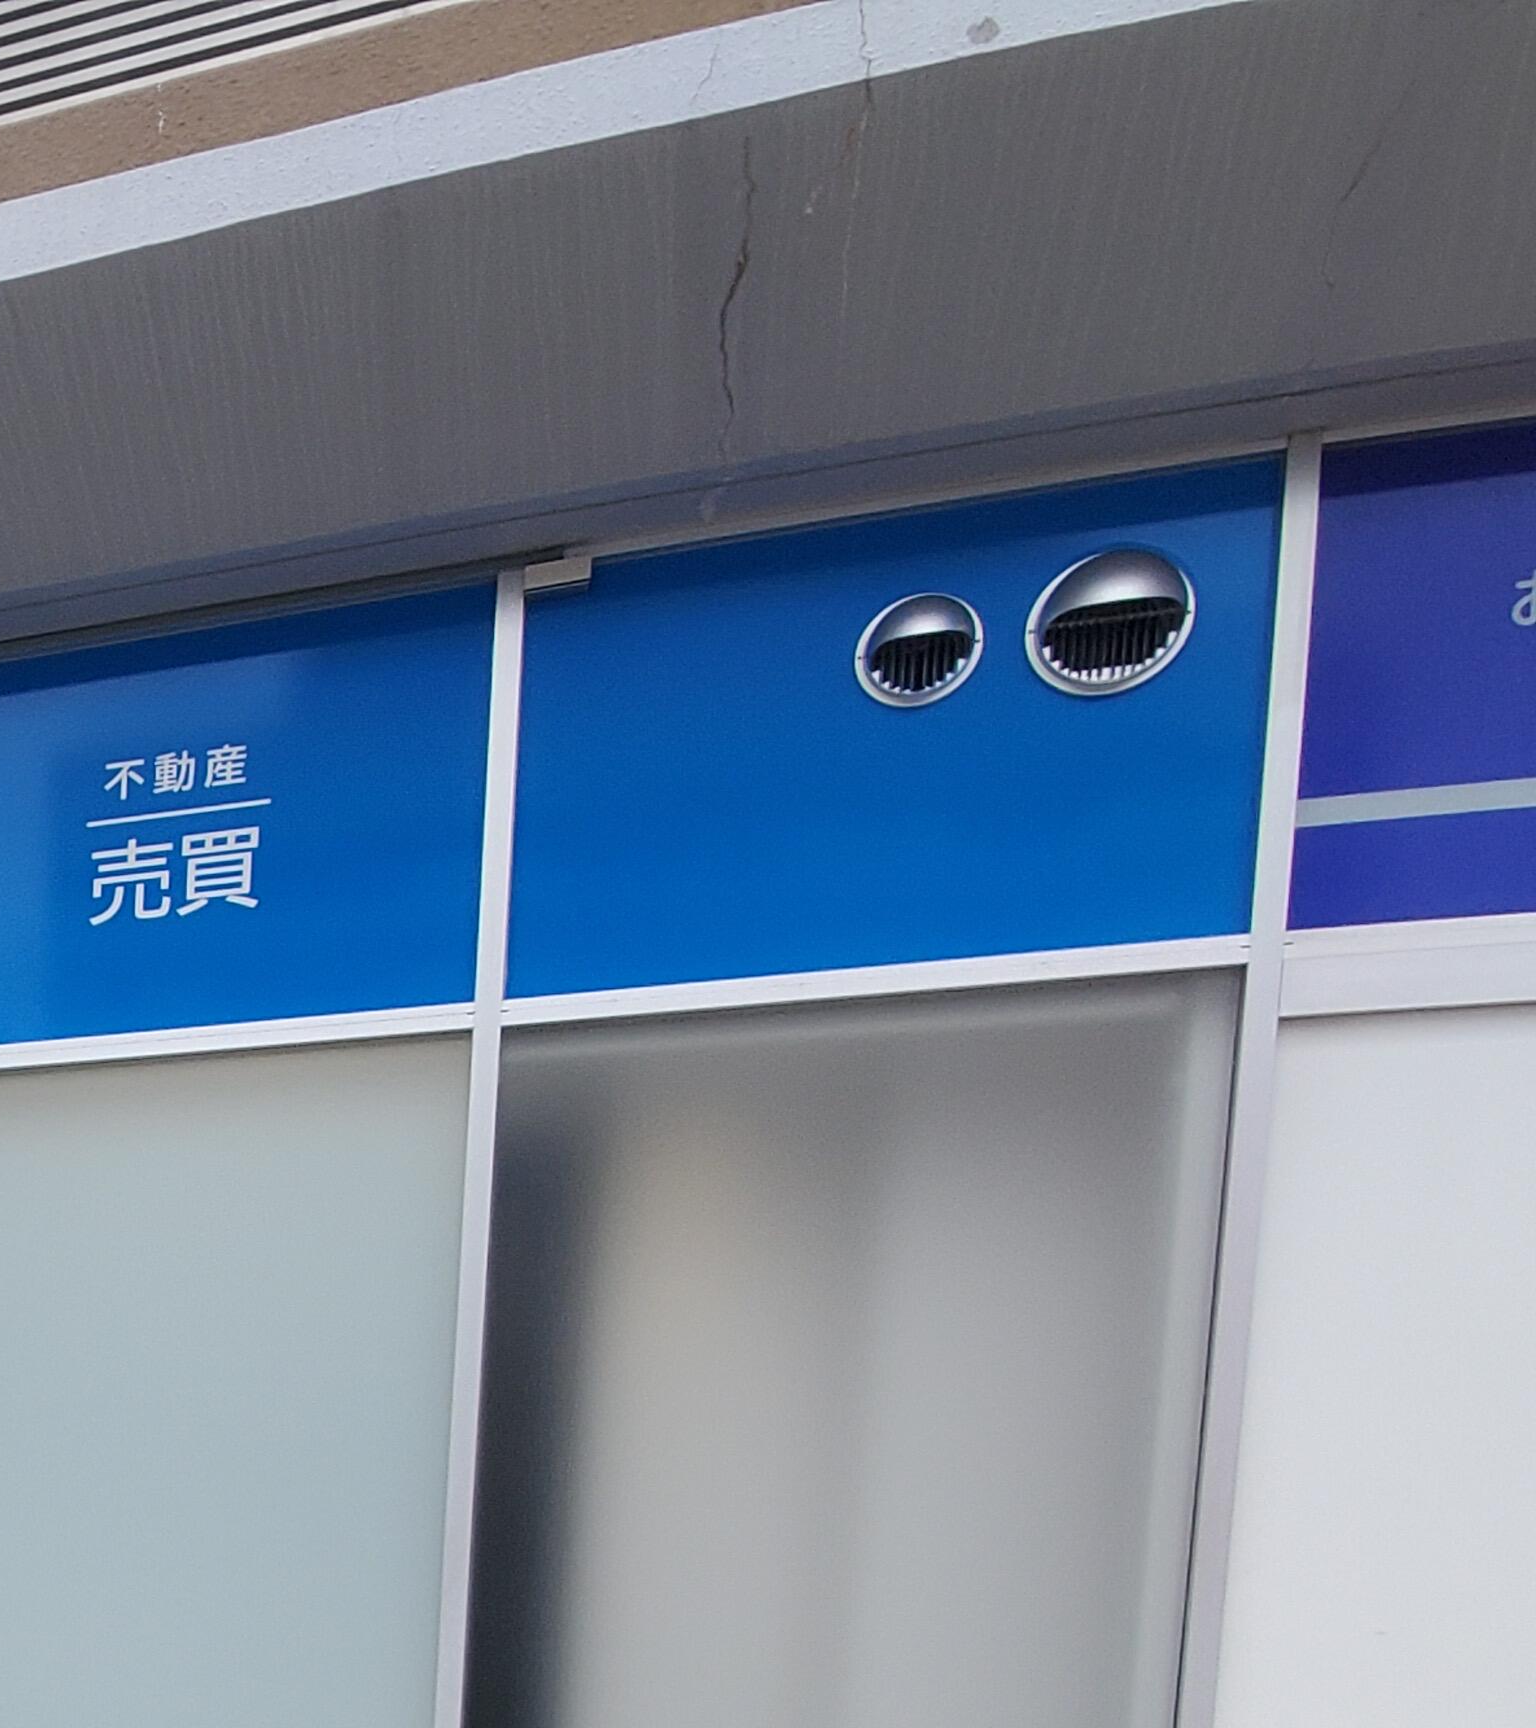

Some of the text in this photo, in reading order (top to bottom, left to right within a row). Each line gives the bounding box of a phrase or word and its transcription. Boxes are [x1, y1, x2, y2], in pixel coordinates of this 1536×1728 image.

[103, 743, 248, 800] 不動産
[88, 825, 261, 926] 売買
